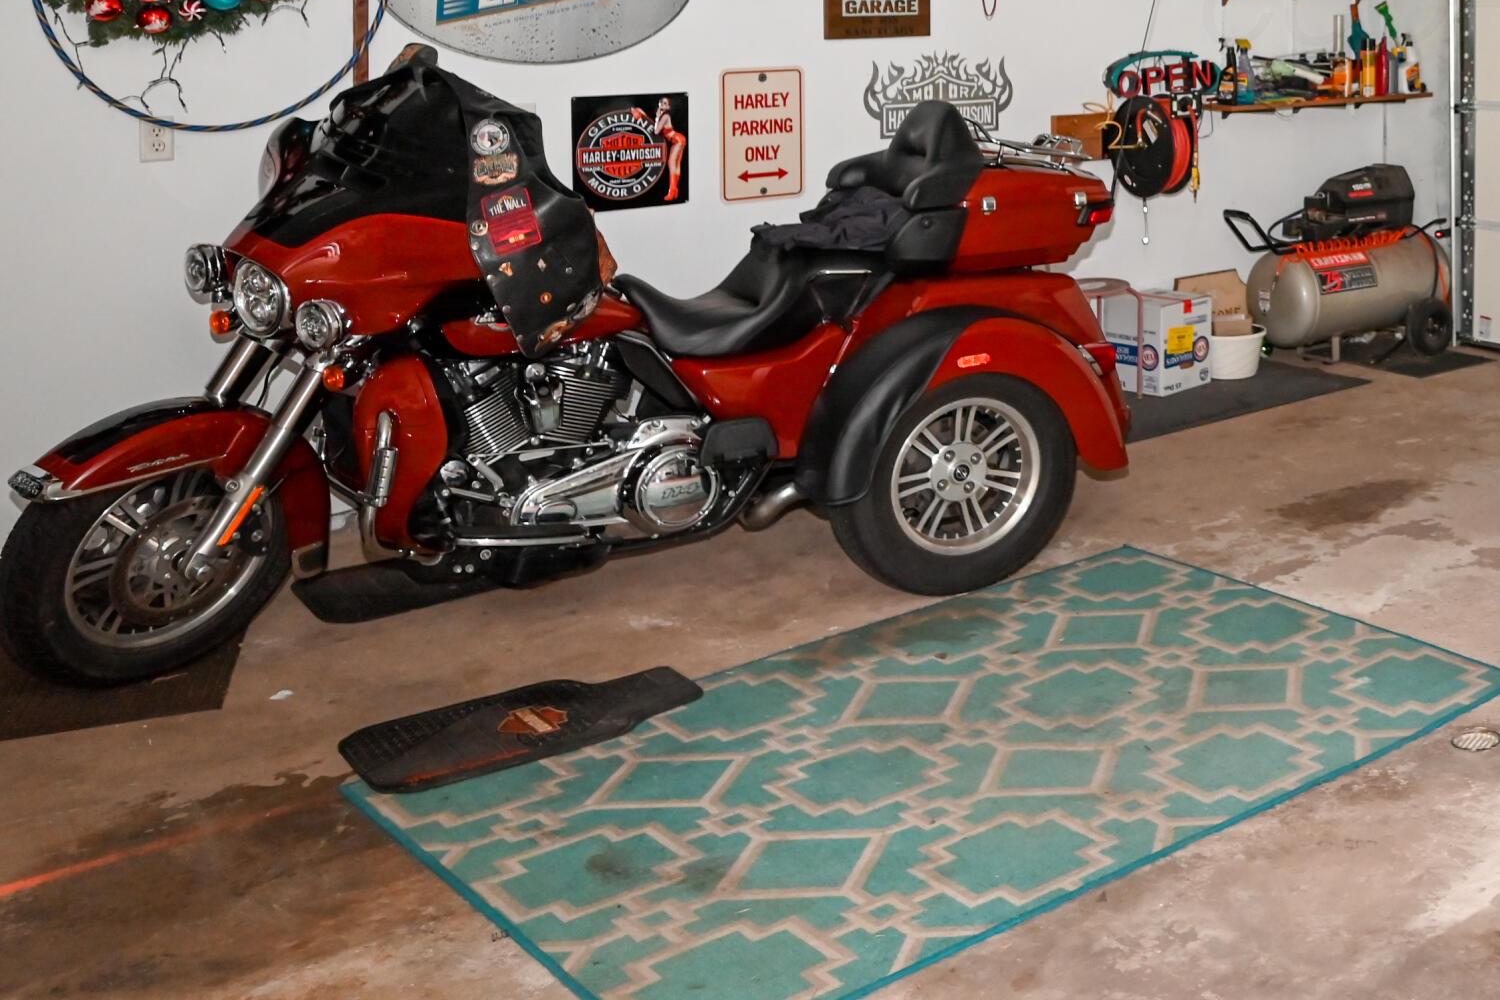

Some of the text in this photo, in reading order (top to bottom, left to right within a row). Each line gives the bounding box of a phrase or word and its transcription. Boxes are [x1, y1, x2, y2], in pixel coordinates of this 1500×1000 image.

[912, 78, 969, 100] MOTOR
[1118, 60, 1212, 98] OPEN
[734, 92, 789, 110] HARLEY
[588, 113, 656, 137] GENUINE
[732, 118, 793, 136] PARKING
[745, 144, 780, 162] ONLY
[588, 174, 657, 197] MOTOR OIL
[489, 198, 526, 216] THE WALL
